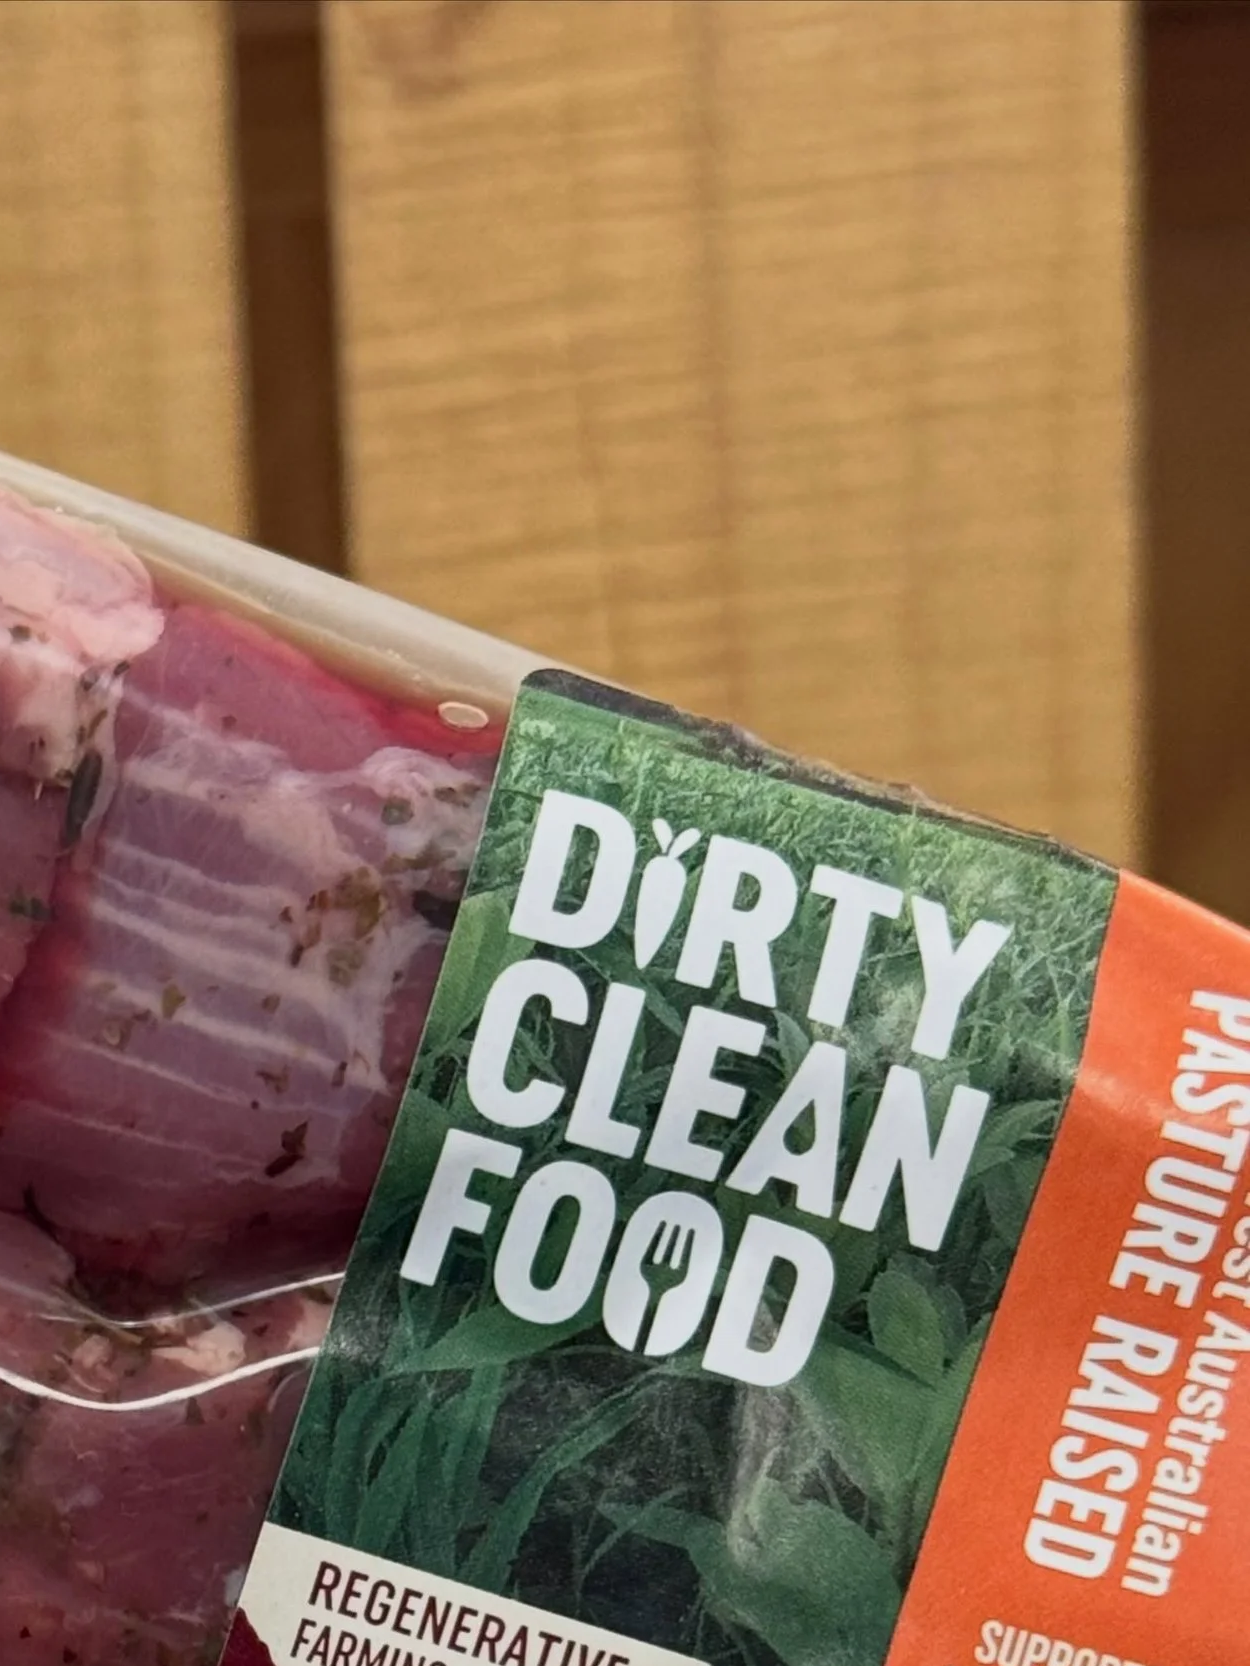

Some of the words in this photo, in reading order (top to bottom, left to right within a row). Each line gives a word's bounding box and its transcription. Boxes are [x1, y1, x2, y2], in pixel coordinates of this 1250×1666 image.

[508, 788, 1014, 1062] DIRTY
[466, 959, 991, 1252] CLEAN
[1109, 990, 1250, 1309] PASTURE
[399, 1129, 836, 1388] FOOD
[1023, 1315, 1179, 1580] RAISED
[1121, 1310, 1250, 1597] Australian
